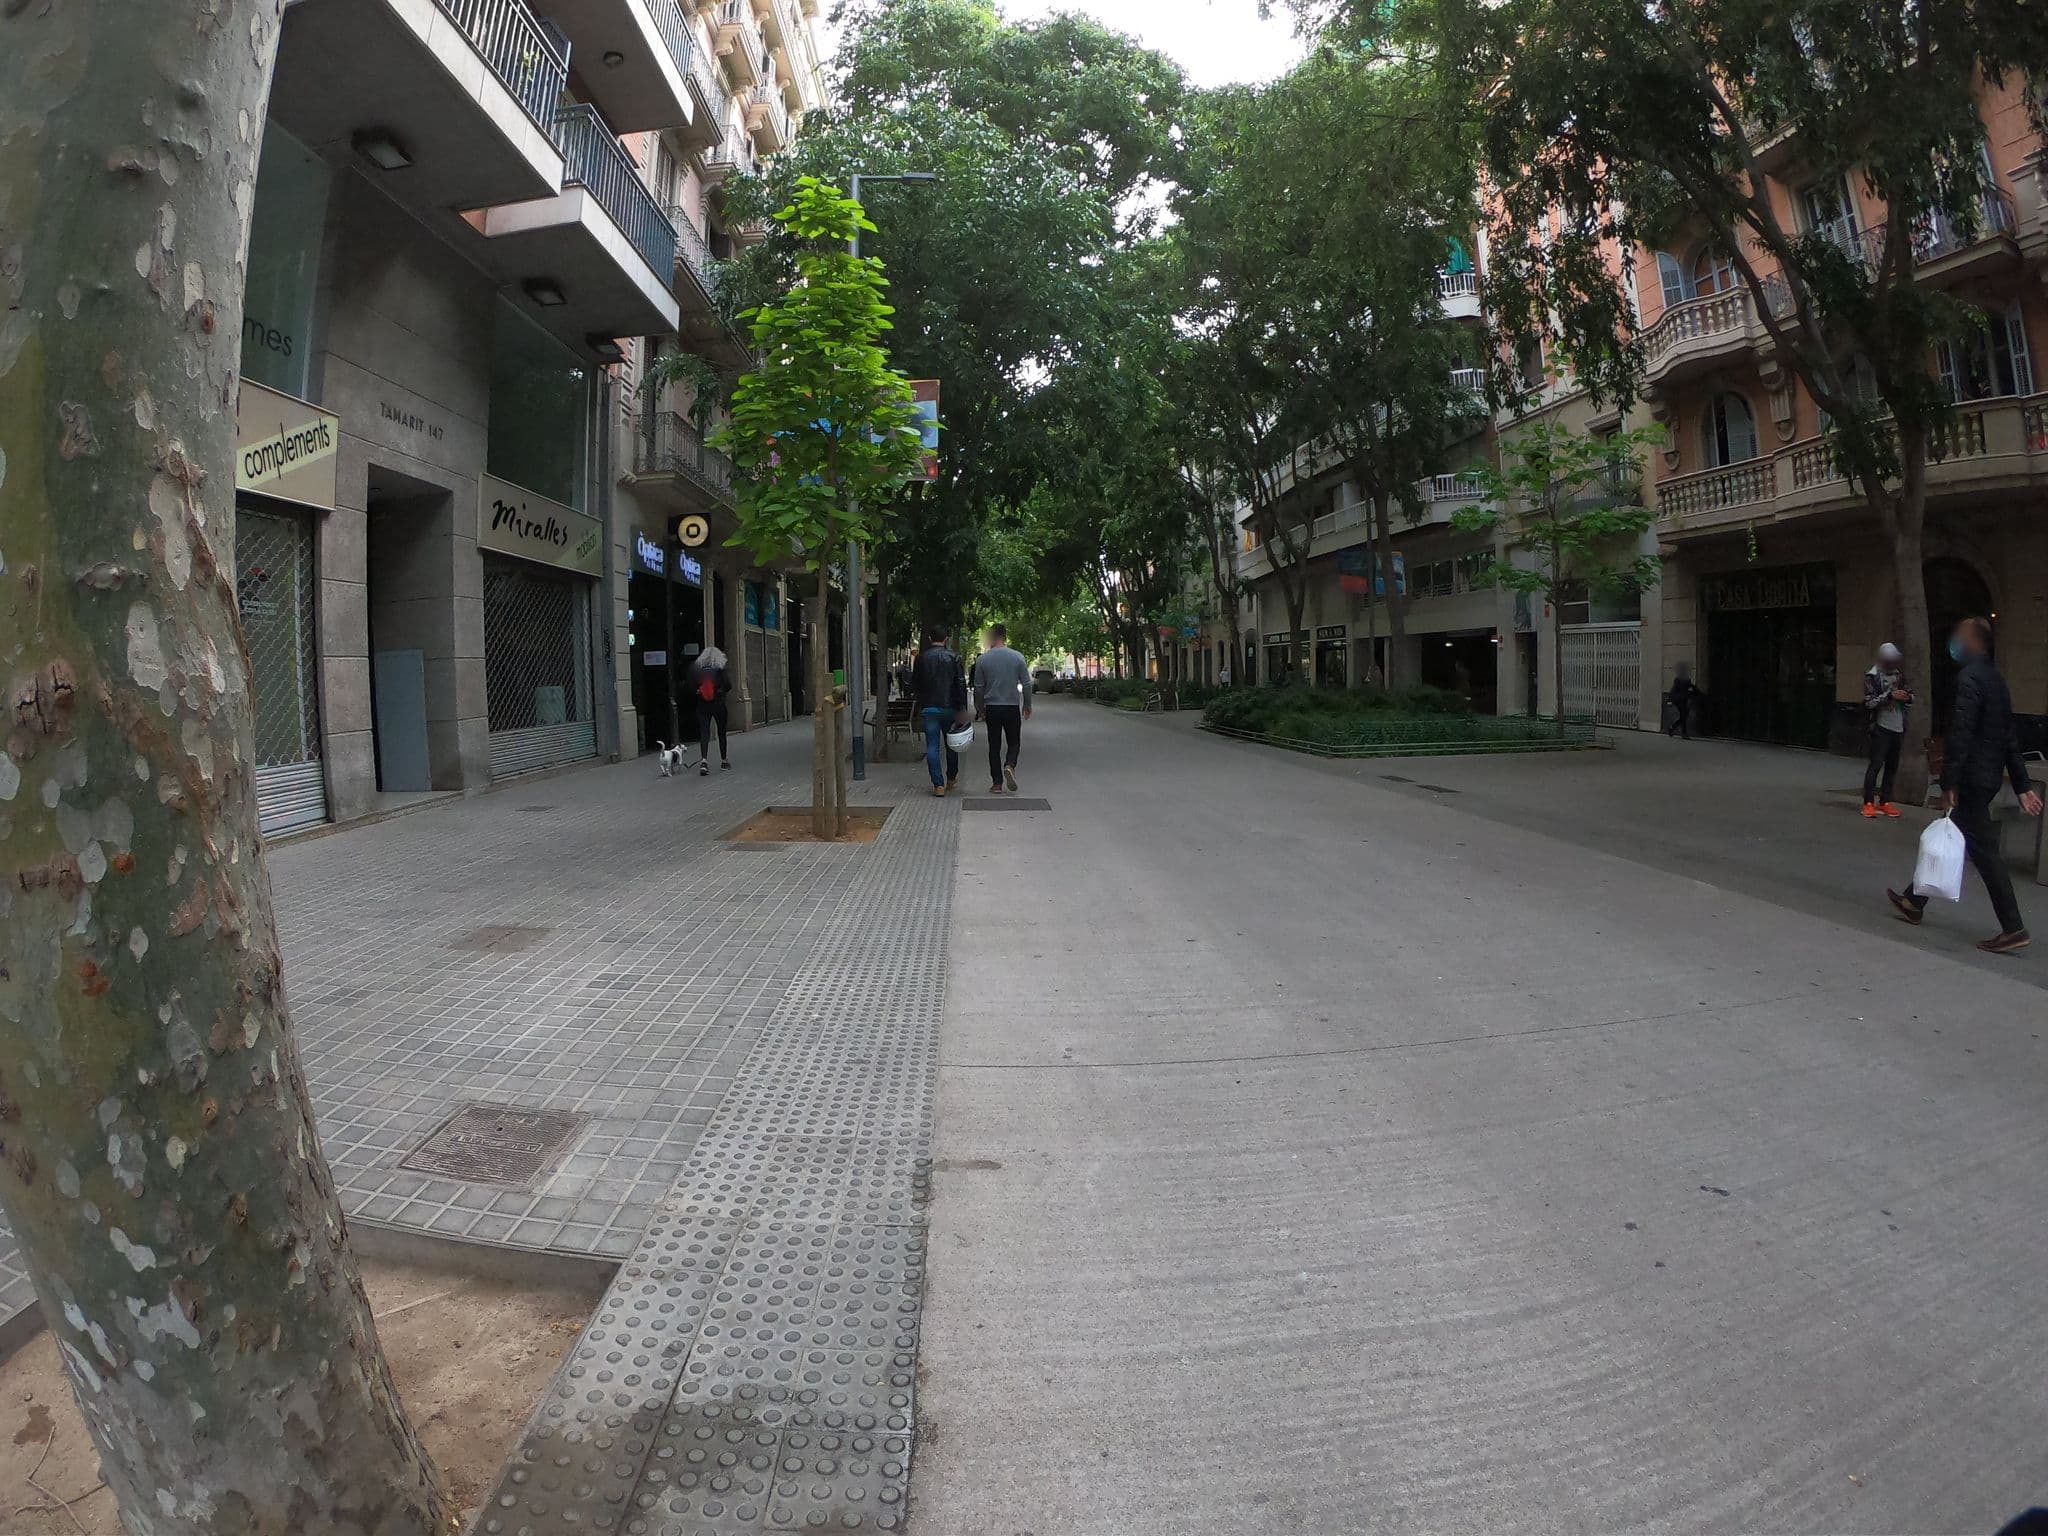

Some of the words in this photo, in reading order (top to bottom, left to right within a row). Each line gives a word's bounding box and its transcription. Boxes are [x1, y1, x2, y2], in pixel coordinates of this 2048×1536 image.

[380, 402, 424, 432] TAMARIT
[429, 424, 444, 440] 147
[244, 418, 330, 480] complements
[492, 500, 568, 546] Miralles
[1718, 584, 1751, 608] CASA
